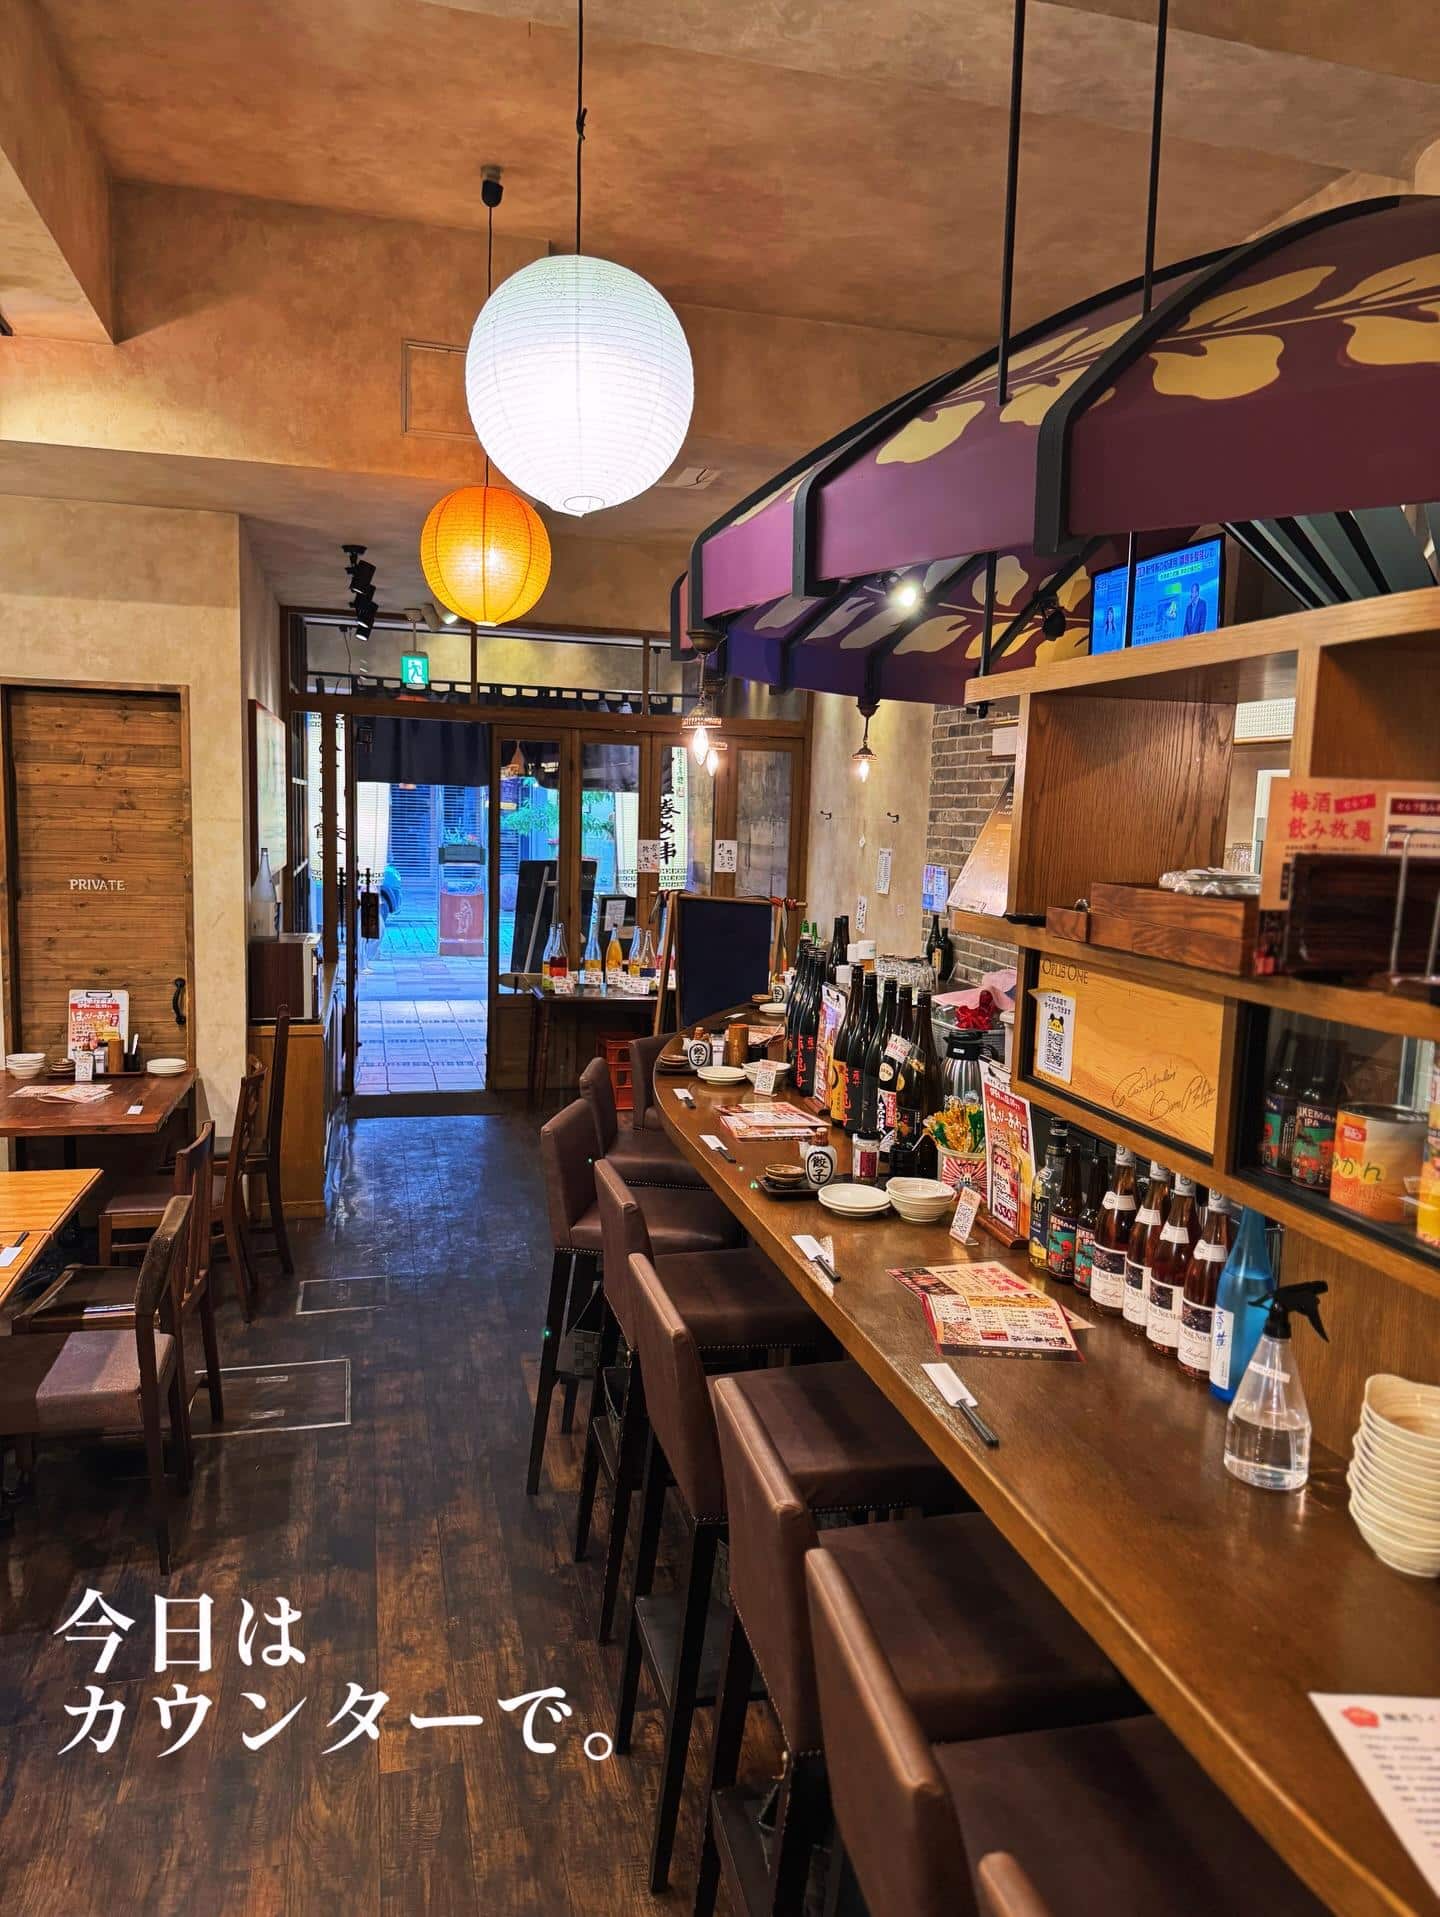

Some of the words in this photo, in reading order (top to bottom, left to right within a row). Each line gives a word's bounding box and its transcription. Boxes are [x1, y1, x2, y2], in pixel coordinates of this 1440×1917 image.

[1290, 791, 1331, 813] 梅酒
[1288, 817, 1371, 842] 飲み放題
[69, 878, 126, 891] PRIVATE
[811, 1155, 829, 1182] 餃子
